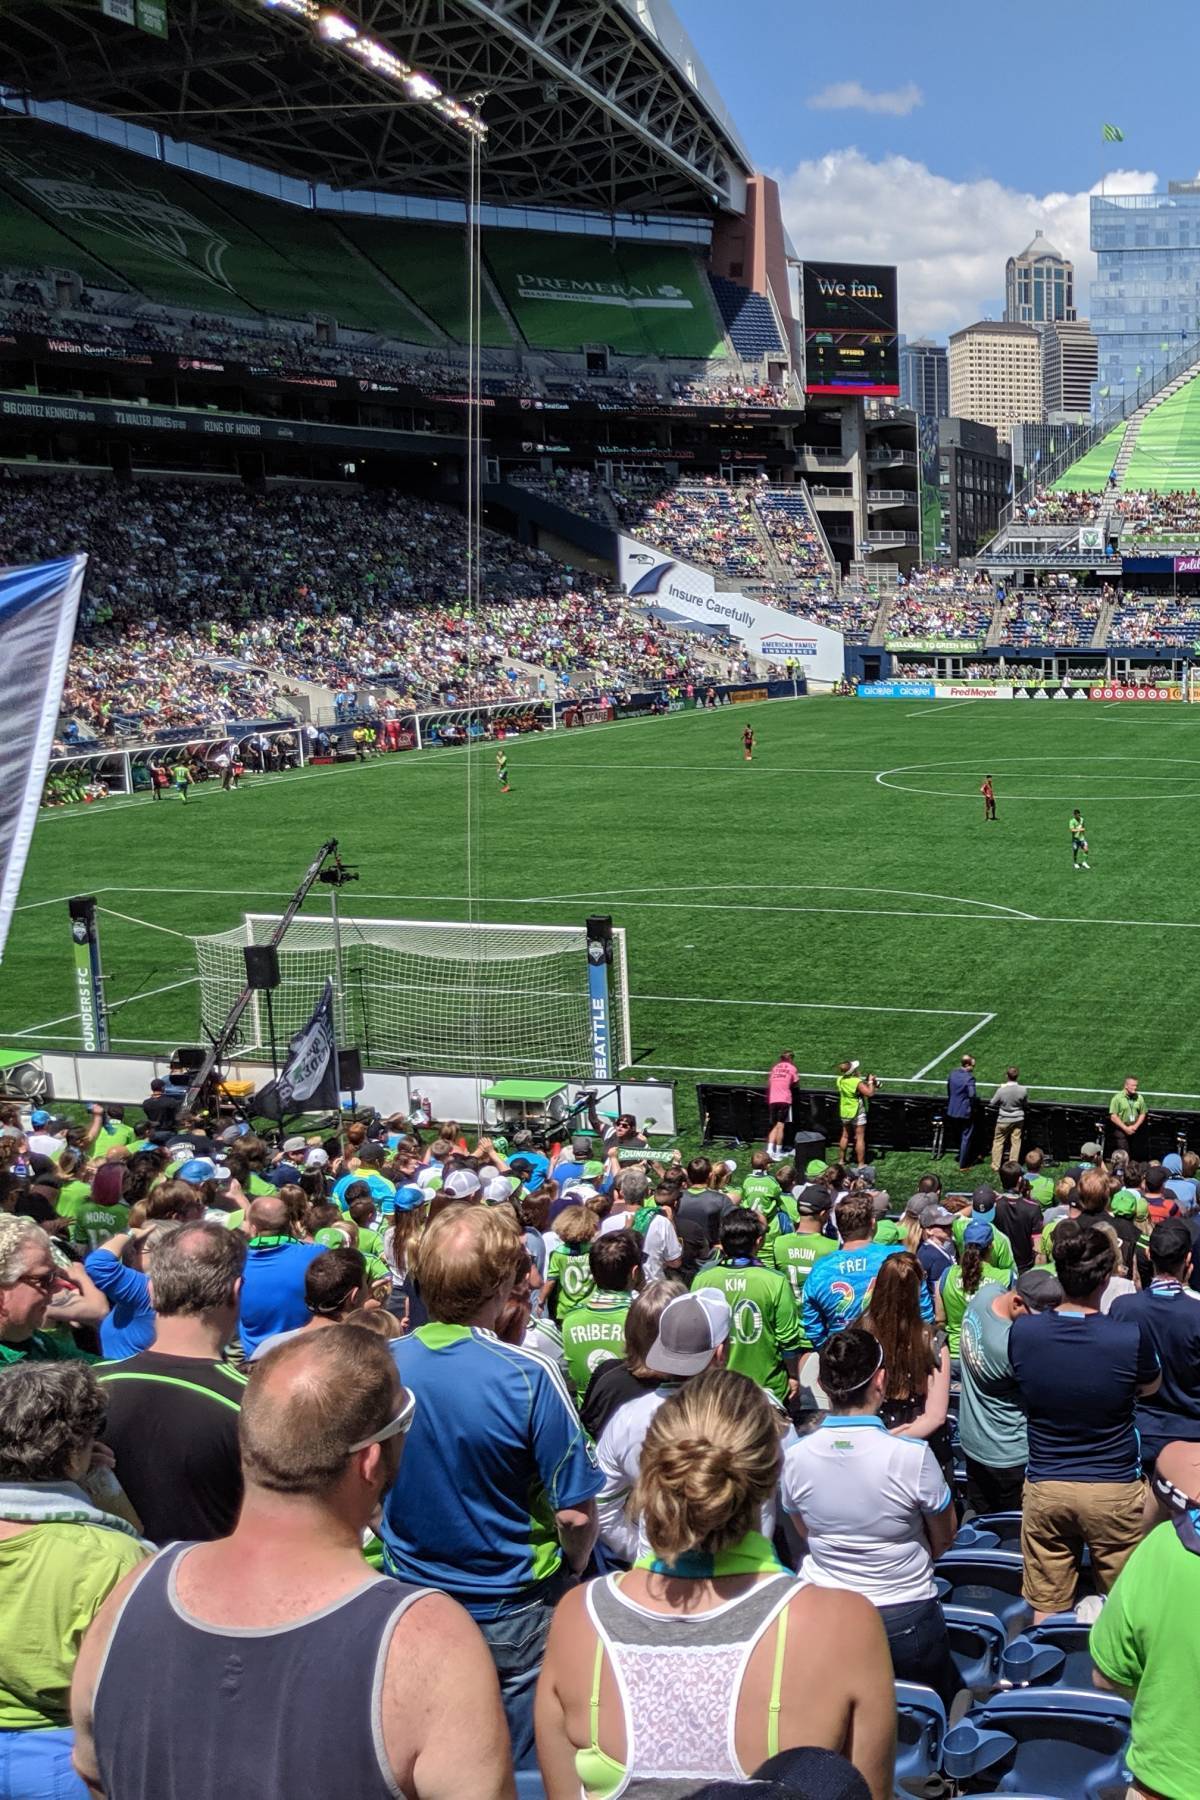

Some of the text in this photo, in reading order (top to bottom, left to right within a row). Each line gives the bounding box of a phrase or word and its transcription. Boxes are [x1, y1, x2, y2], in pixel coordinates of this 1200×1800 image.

[516, 273, 644, 297] PREMERA
[817, 279, 884, 298] We fan.
[17, 404, 45, 417] CORTEZ
[45, 406, 78, 419] KENNEDY
[204, 421, 261, 435] RING OF HONOR
[668, 583, 756, 629] Insure Carefully
[891, 641, 923, 649] WELCOME
[936, 642, 959, 650] GREEN
[960, 641, 977, 649] HELL
[78, 967, 89, 985] FC
[593, 997, 608, 1079] SEATTLE
[619, 1150, 662, 1160] SOUNDERS
[787, 1247, 816, 1260] BRUIN
[839, 1258, 867, 1274] FREI
[725, 1278, 747, 1292] KIM
